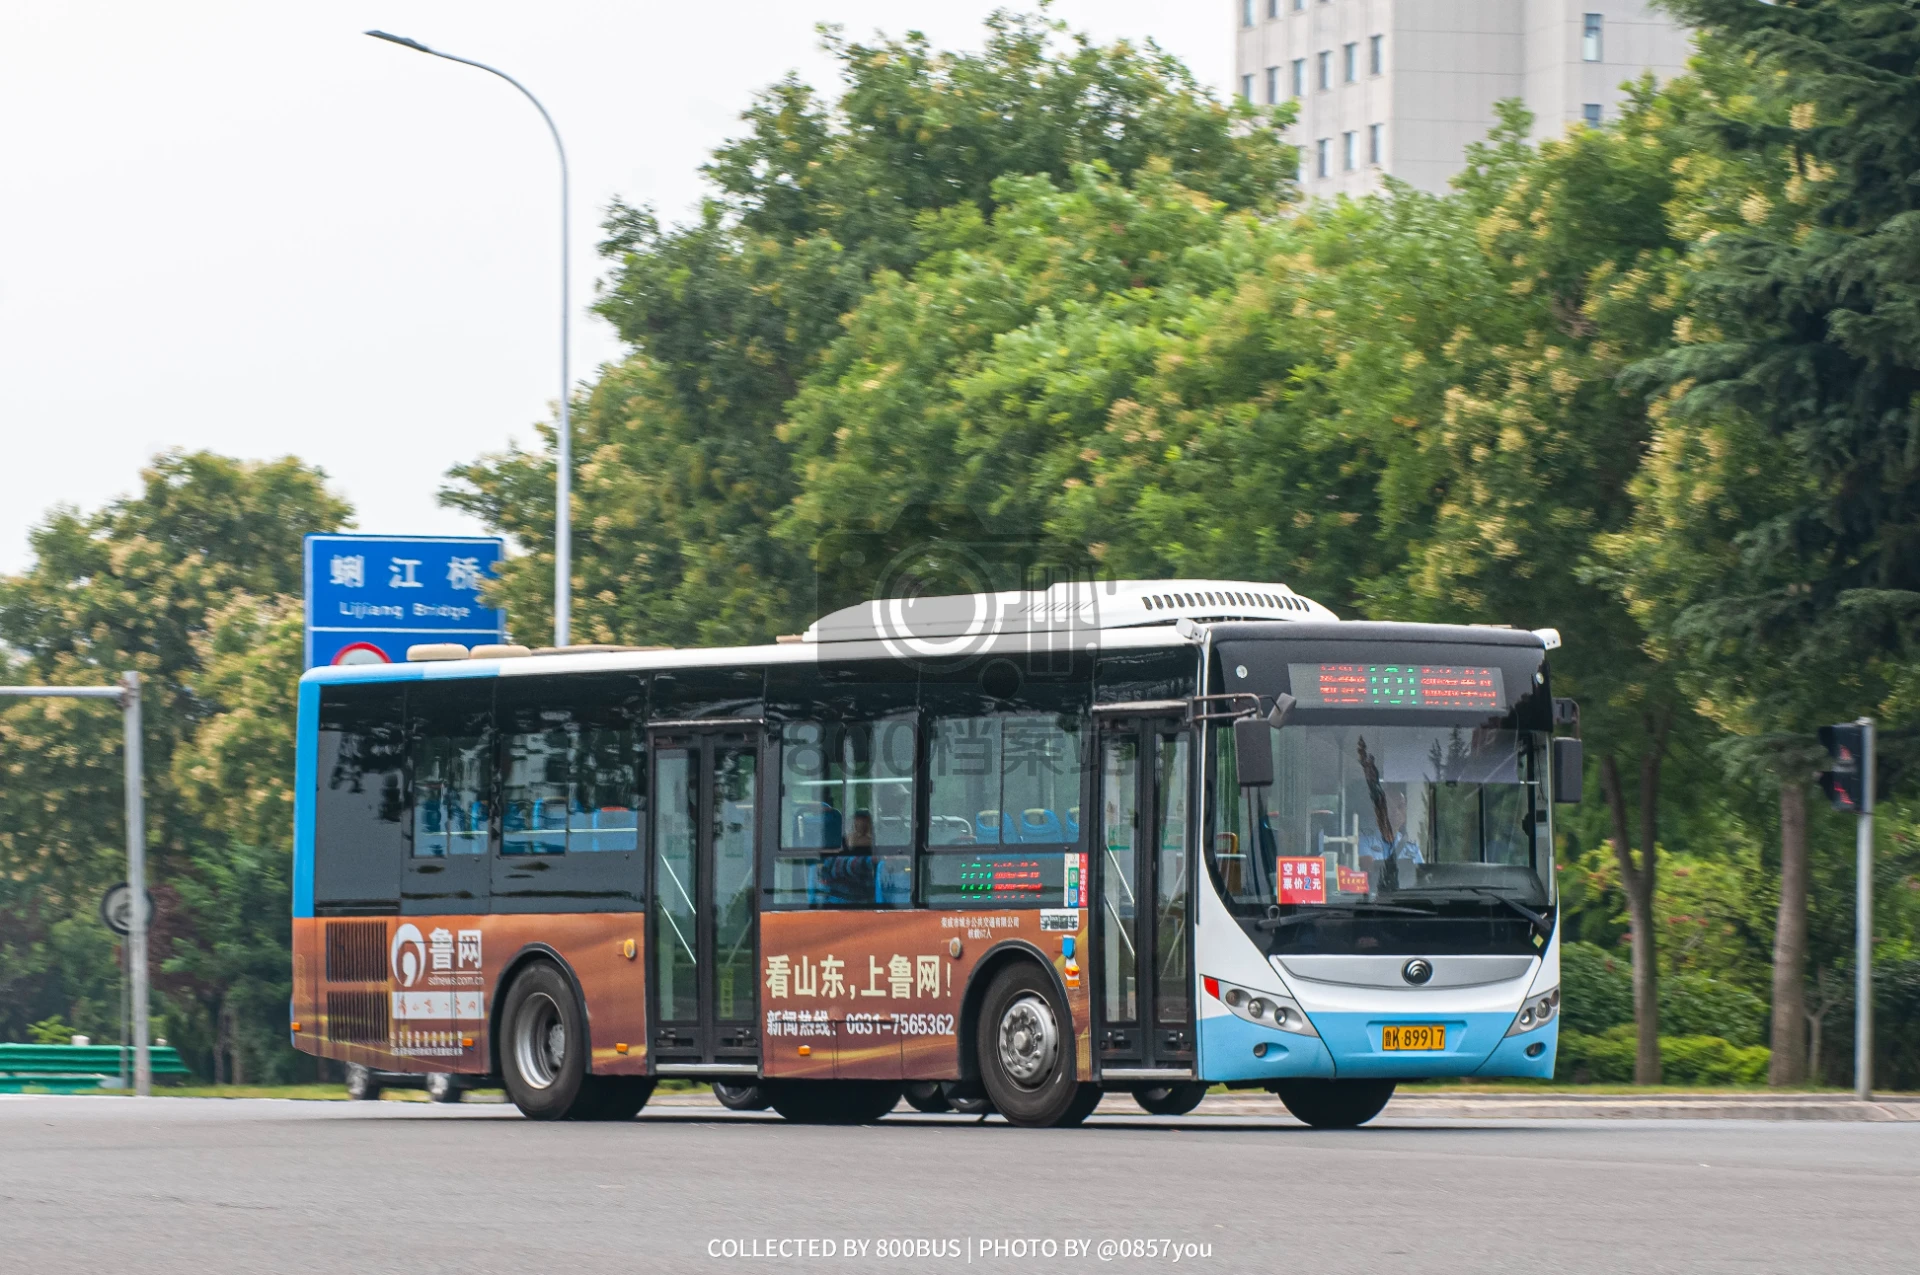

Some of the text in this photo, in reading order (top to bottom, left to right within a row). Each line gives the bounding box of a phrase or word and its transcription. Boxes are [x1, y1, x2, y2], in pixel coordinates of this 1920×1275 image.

[339, 601, 471, 621] Lijiang Bridge
[1283, 862, 1321, 876] 空调车
[1283, 876, 1322, 891] 票价2元
[428, 926, 482, 970] 鲁网
[765, 953, 952, 999] 看山东，上鲁网！
[766, 1010, 955, 1036] 新闻热线： 0631-7565362
